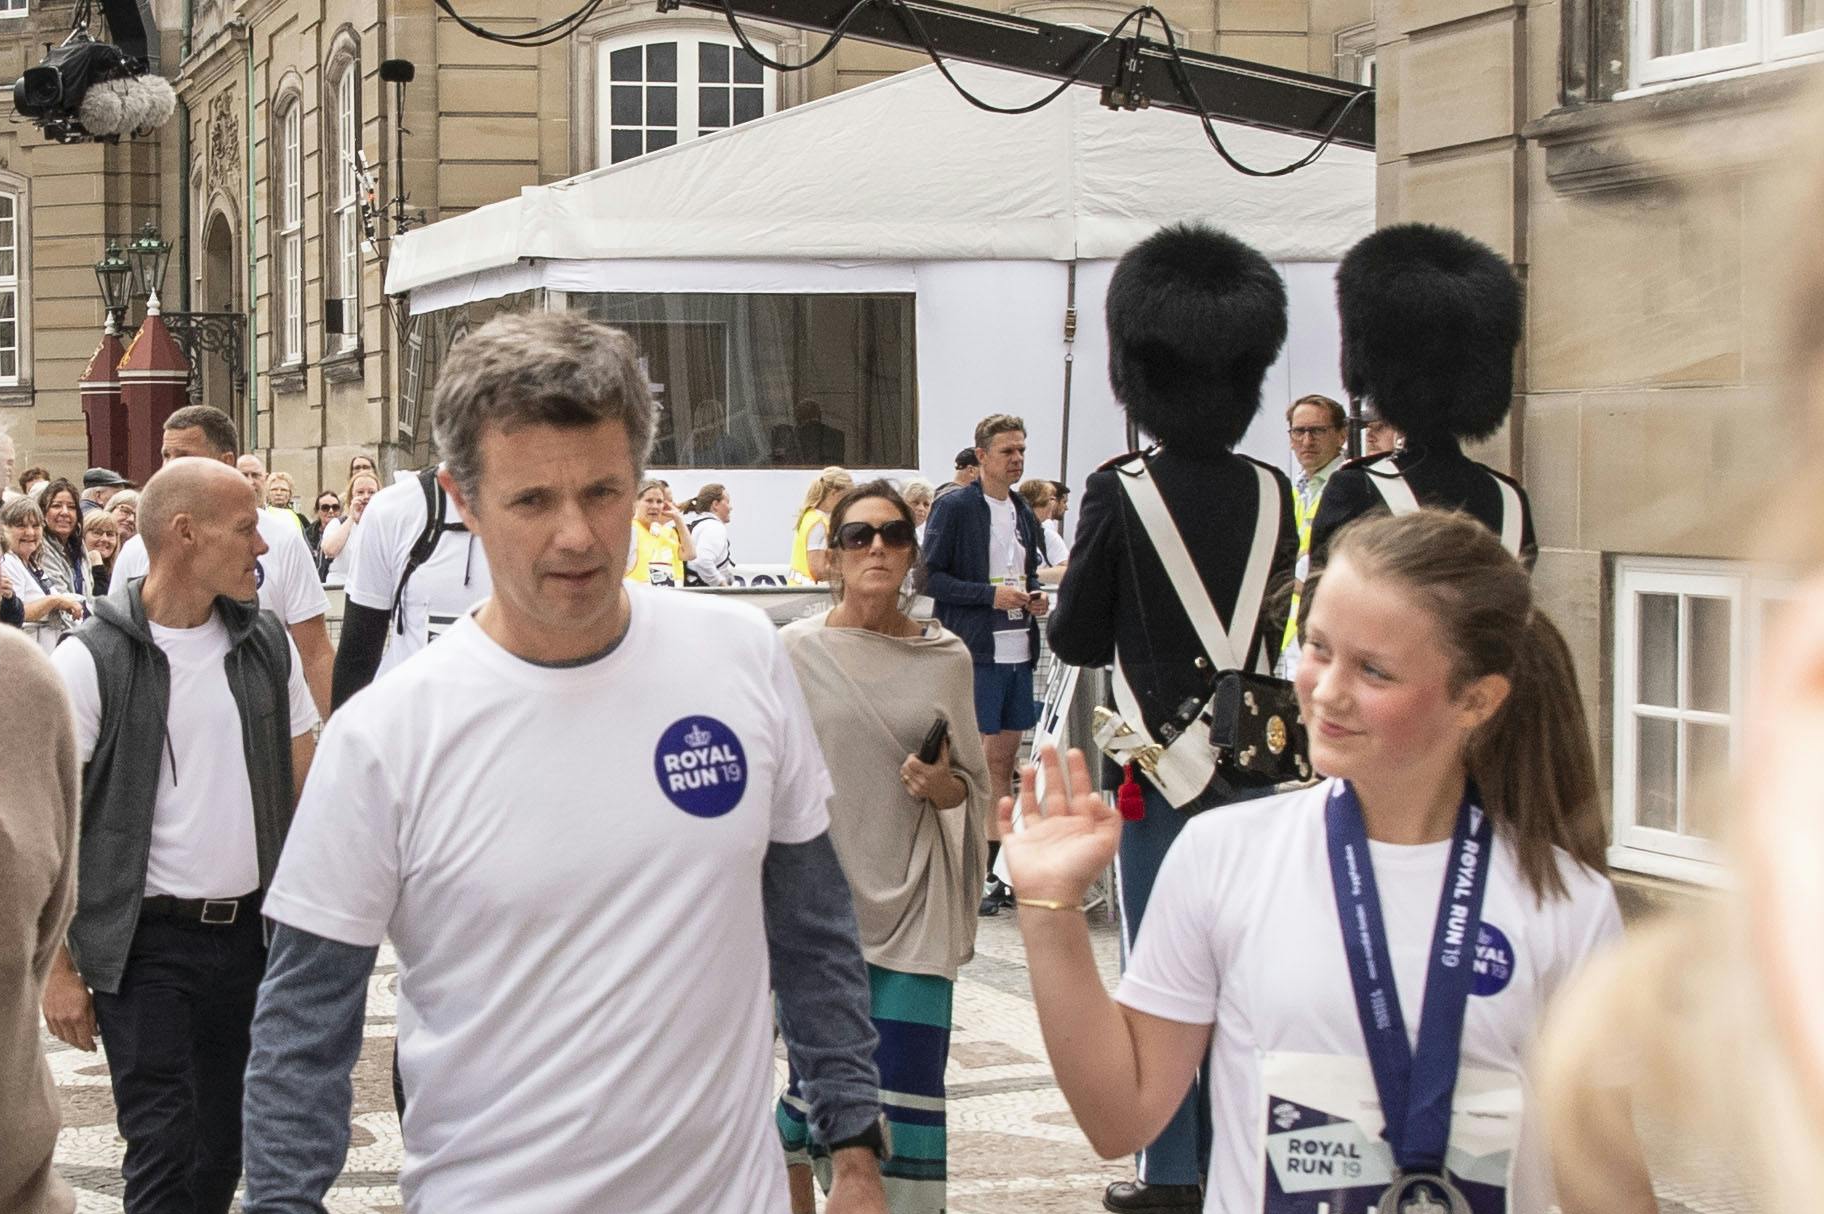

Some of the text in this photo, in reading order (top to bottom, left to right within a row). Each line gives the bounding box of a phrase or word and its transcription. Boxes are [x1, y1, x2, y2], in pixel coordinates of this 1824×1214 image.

[663, 744, 738, 773] ROYAL
[667, 762, 743, 793] RUN 19
[1440, 838, 1480, 968] ROYAL RUN 19
[1288, 1138, 1362, 1160] ROYAL
[1287, 1157, 1362, 1178] RUN 19
